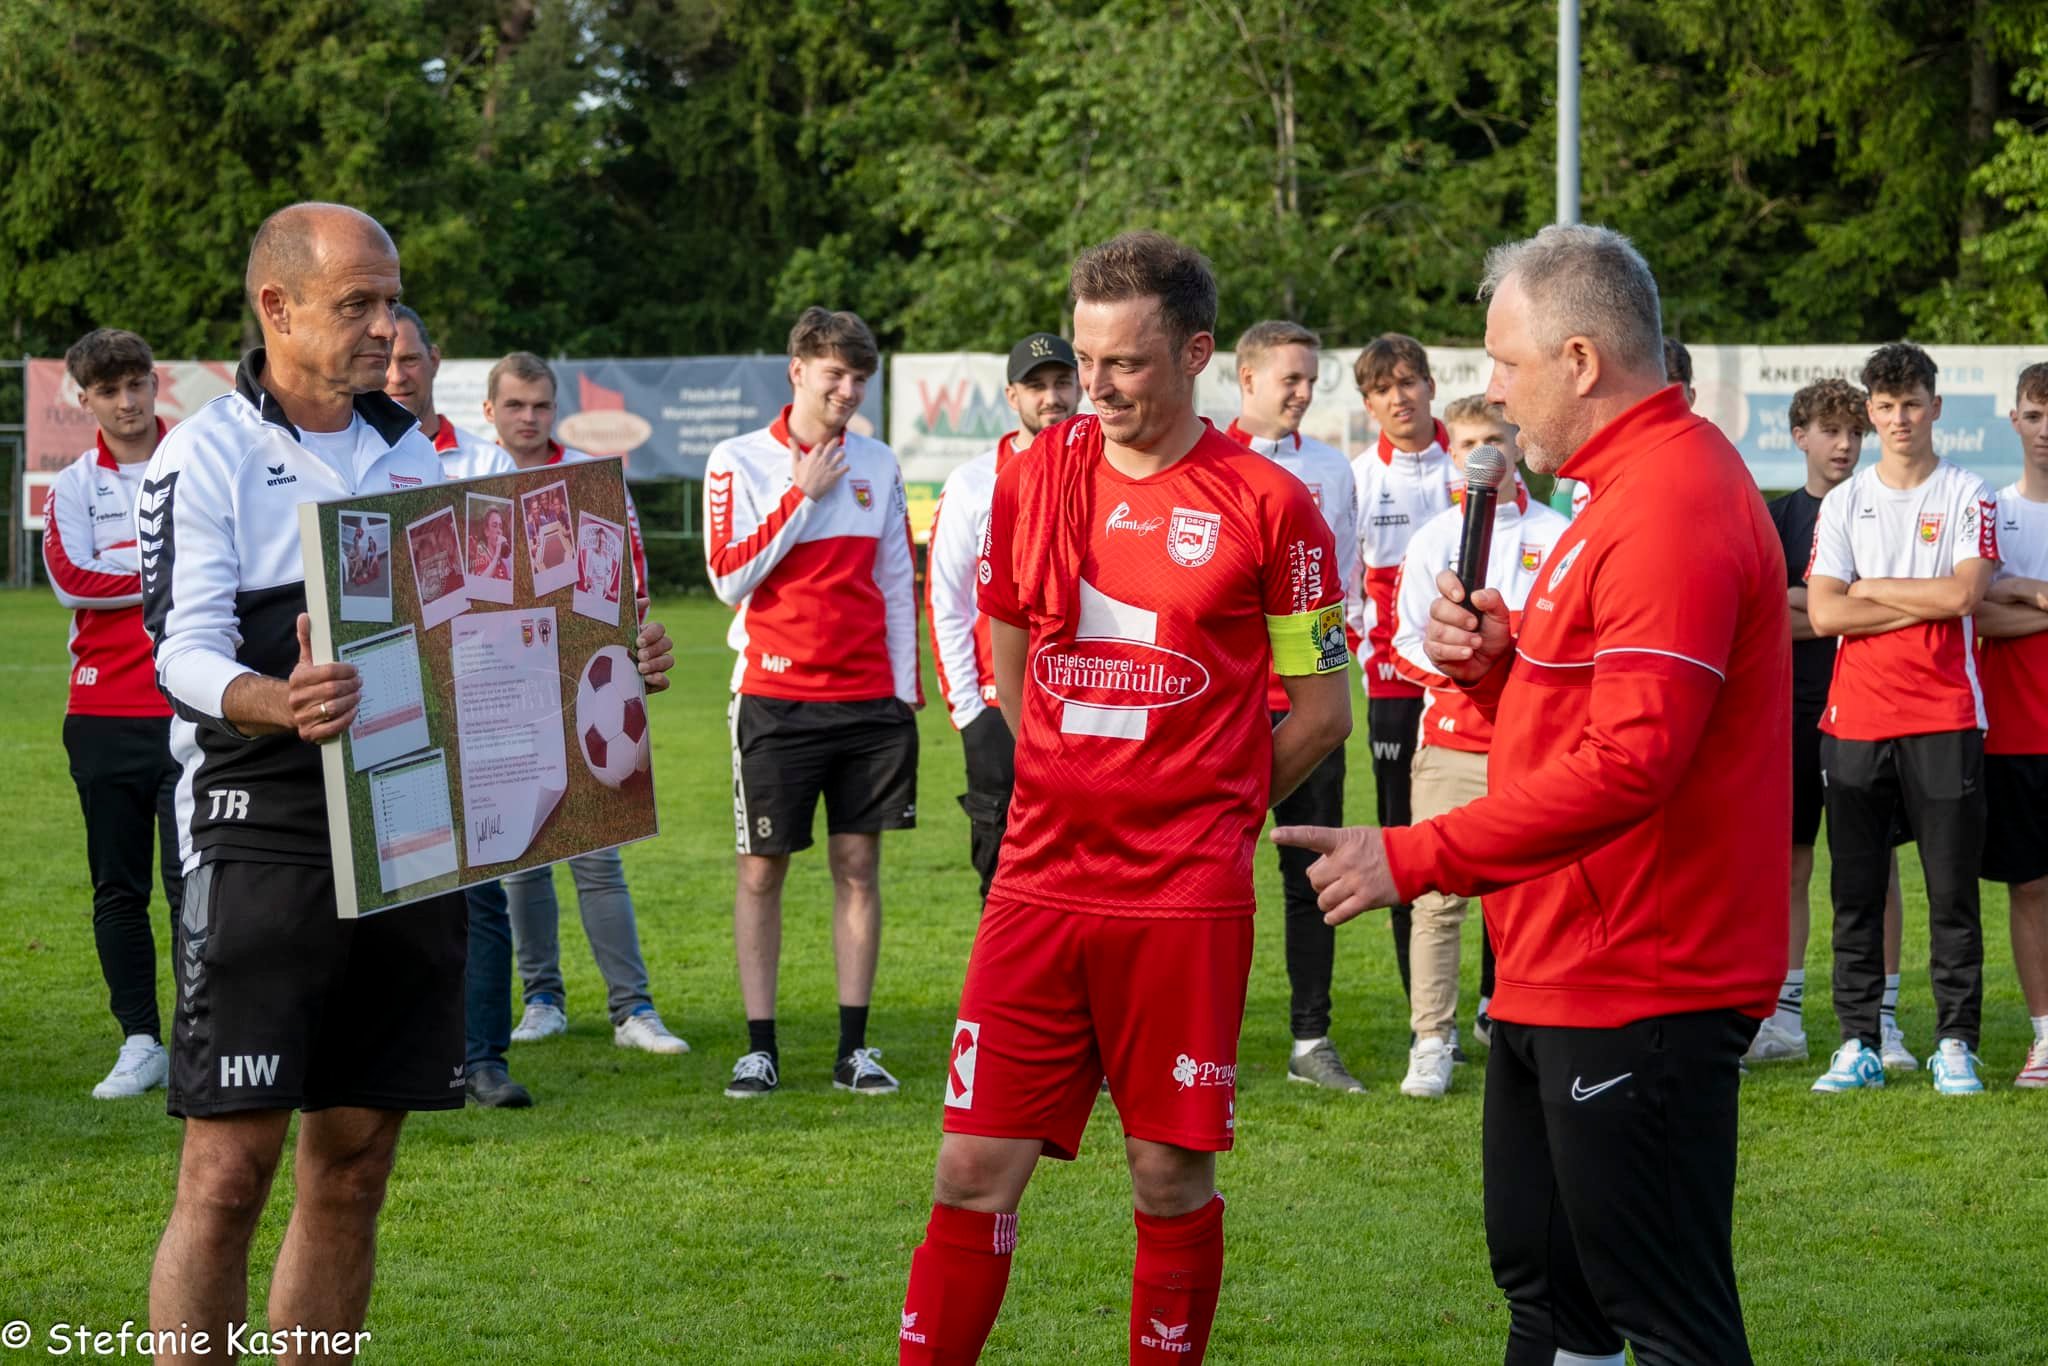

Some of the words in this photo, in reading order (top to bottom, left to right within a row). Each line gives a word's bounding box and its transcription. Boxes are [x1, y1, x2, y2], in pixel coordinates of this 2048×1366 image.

[266, 474, 297, 487] erima
[1307, 546, 1323, 601] Penn
[761, 653, 792, 673] MP
[1057, 654, 1134, 672] Fleischerei
[76, 666, 99, 686] DB
[1042, 655, 1192, 695] Traunmüller
[208, 789, 250, 820] TR
[757, 816, 773, 838] 8
[220, 1054, 280, 1088] HW
[1141, 1335, 1191, 1353] erima
